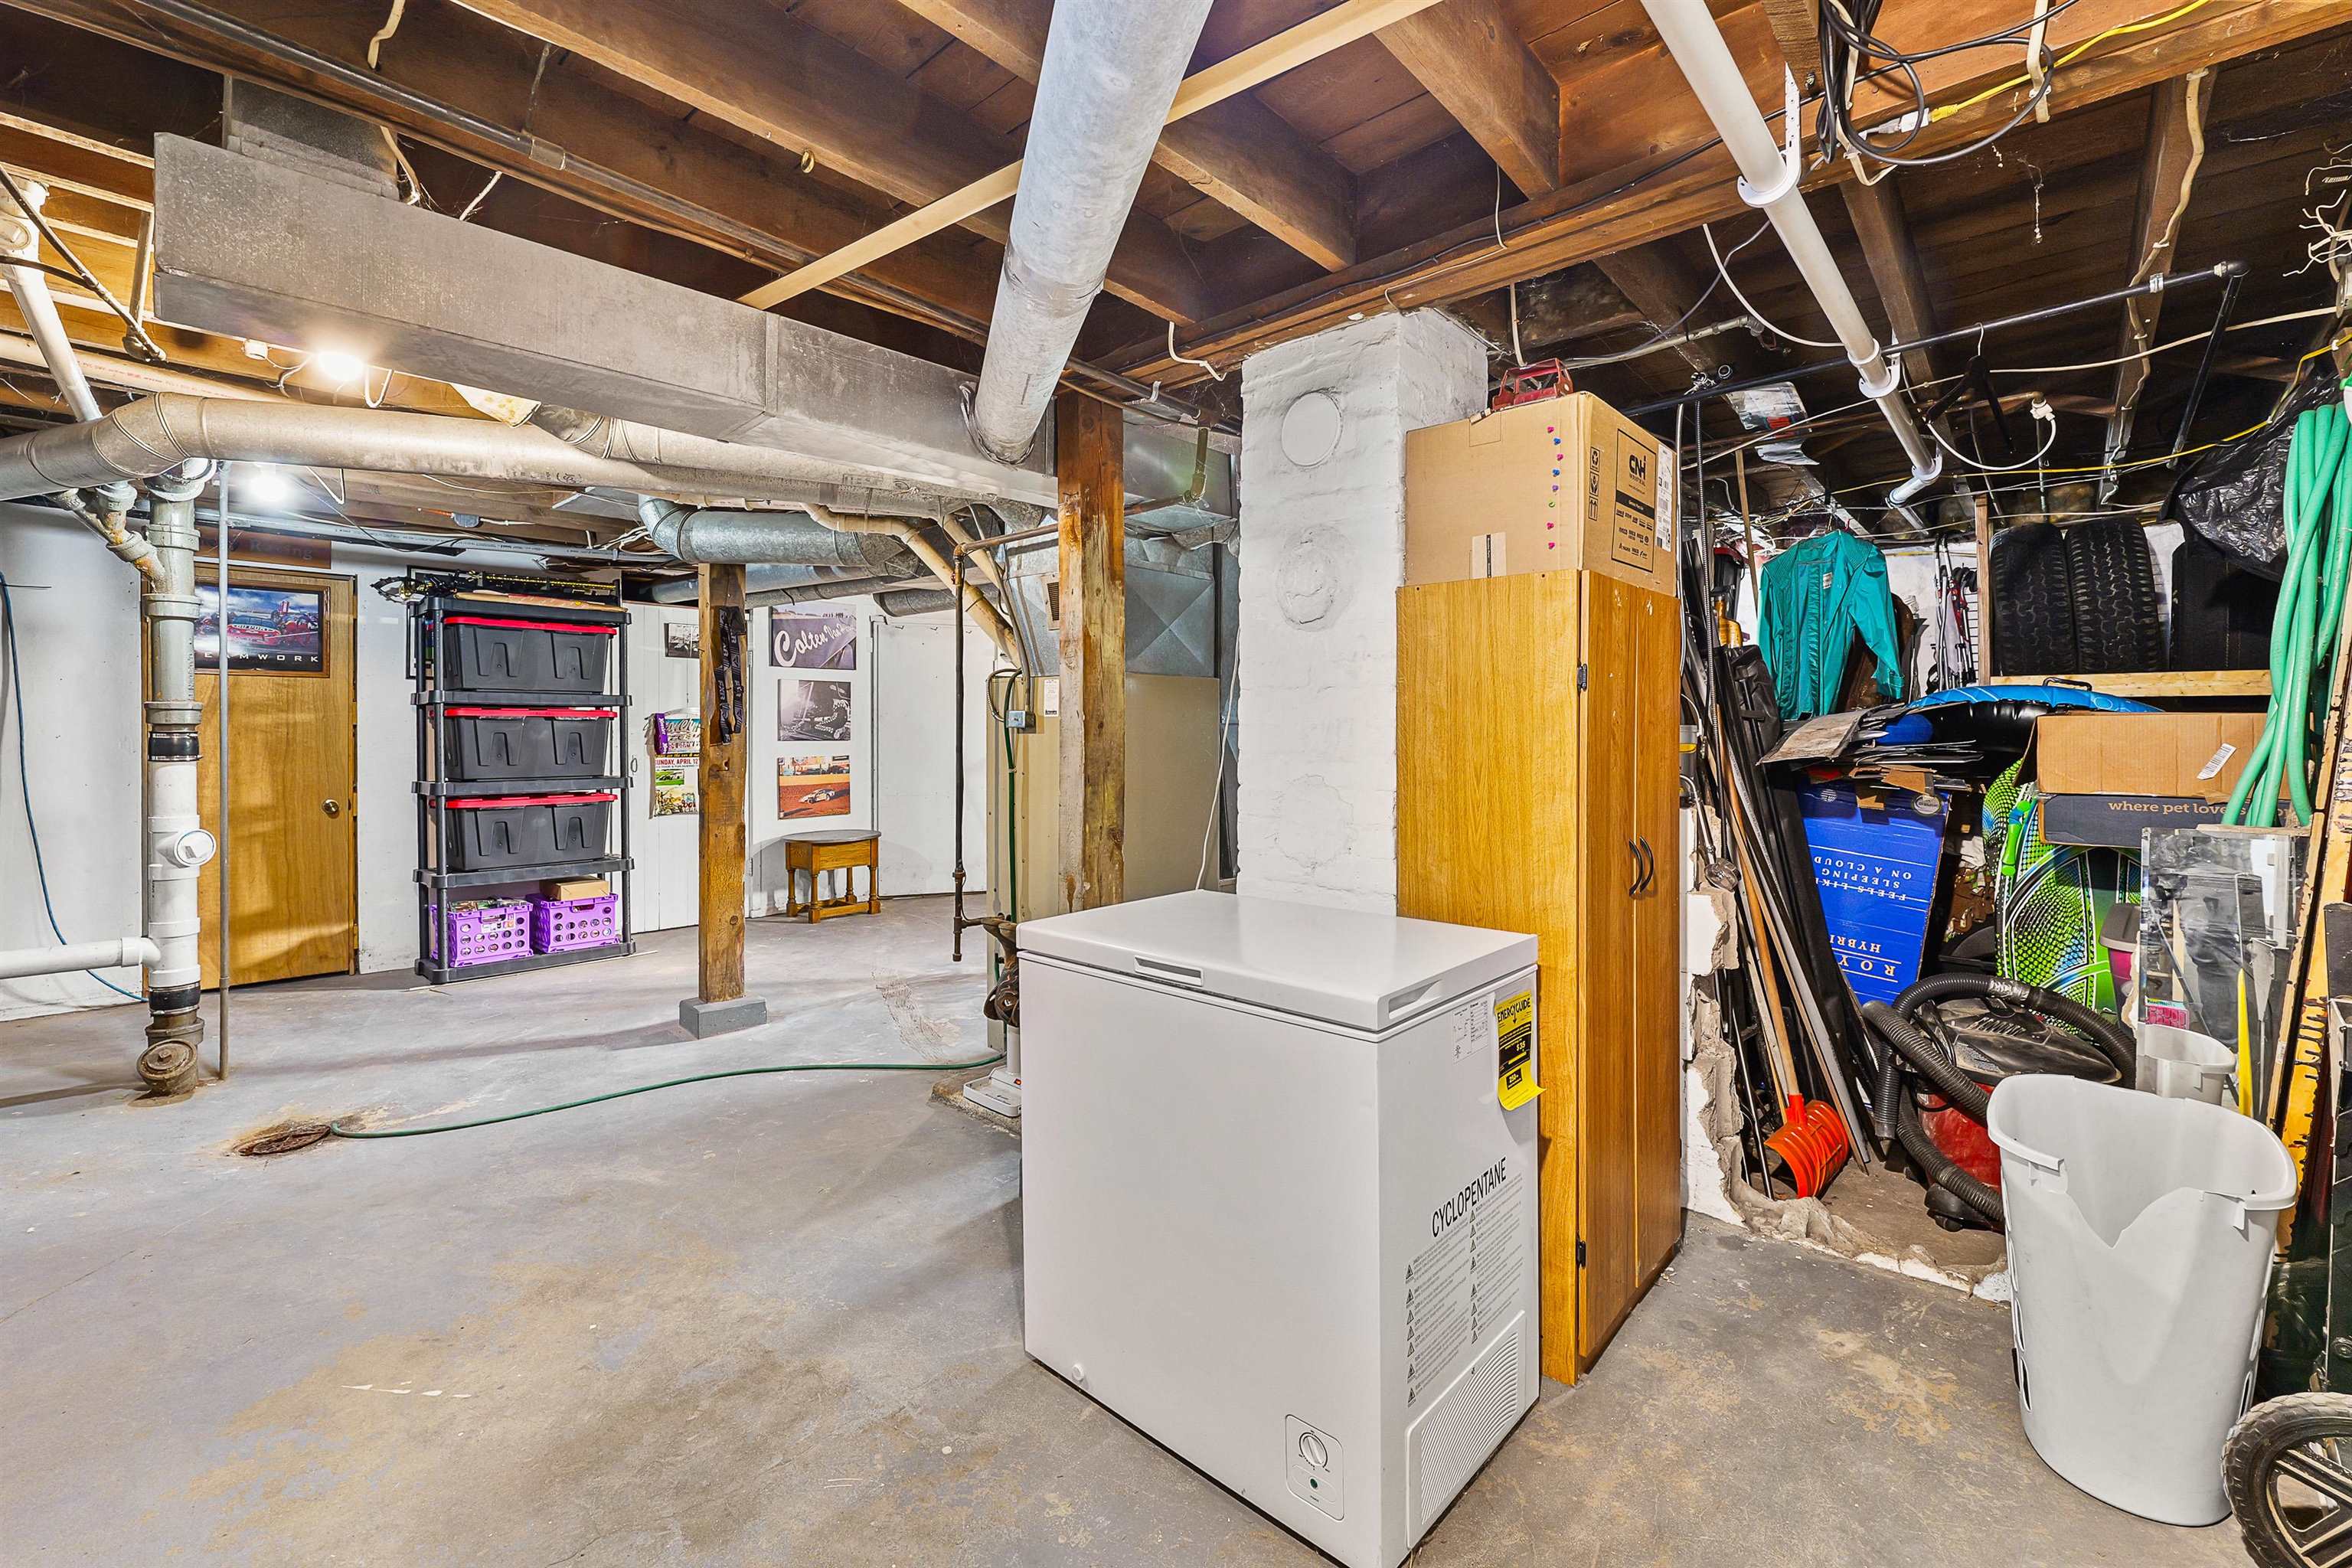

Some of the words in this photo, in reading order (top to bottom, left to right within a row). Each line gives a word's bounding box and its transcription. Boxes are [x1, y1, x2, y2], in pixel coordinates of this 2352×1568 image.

[774, 630, 828, 667] Colten
[204, 652, 318, 662] EMWORK
[2108, 801, 2158, 812] where
[2163, 802, 2190, 814] pet
[2193, 802, 2247, 815] loves
[1814, 856, 1866, 871] CLOUD
[1821, 867, 1900, 888] SLEEPING
[1891, 869, 1912, 880] ON
[1857, 885, 1906, 901] FEELS
[1432, 1156, 1507, 1238] CYCLOPENTANE
